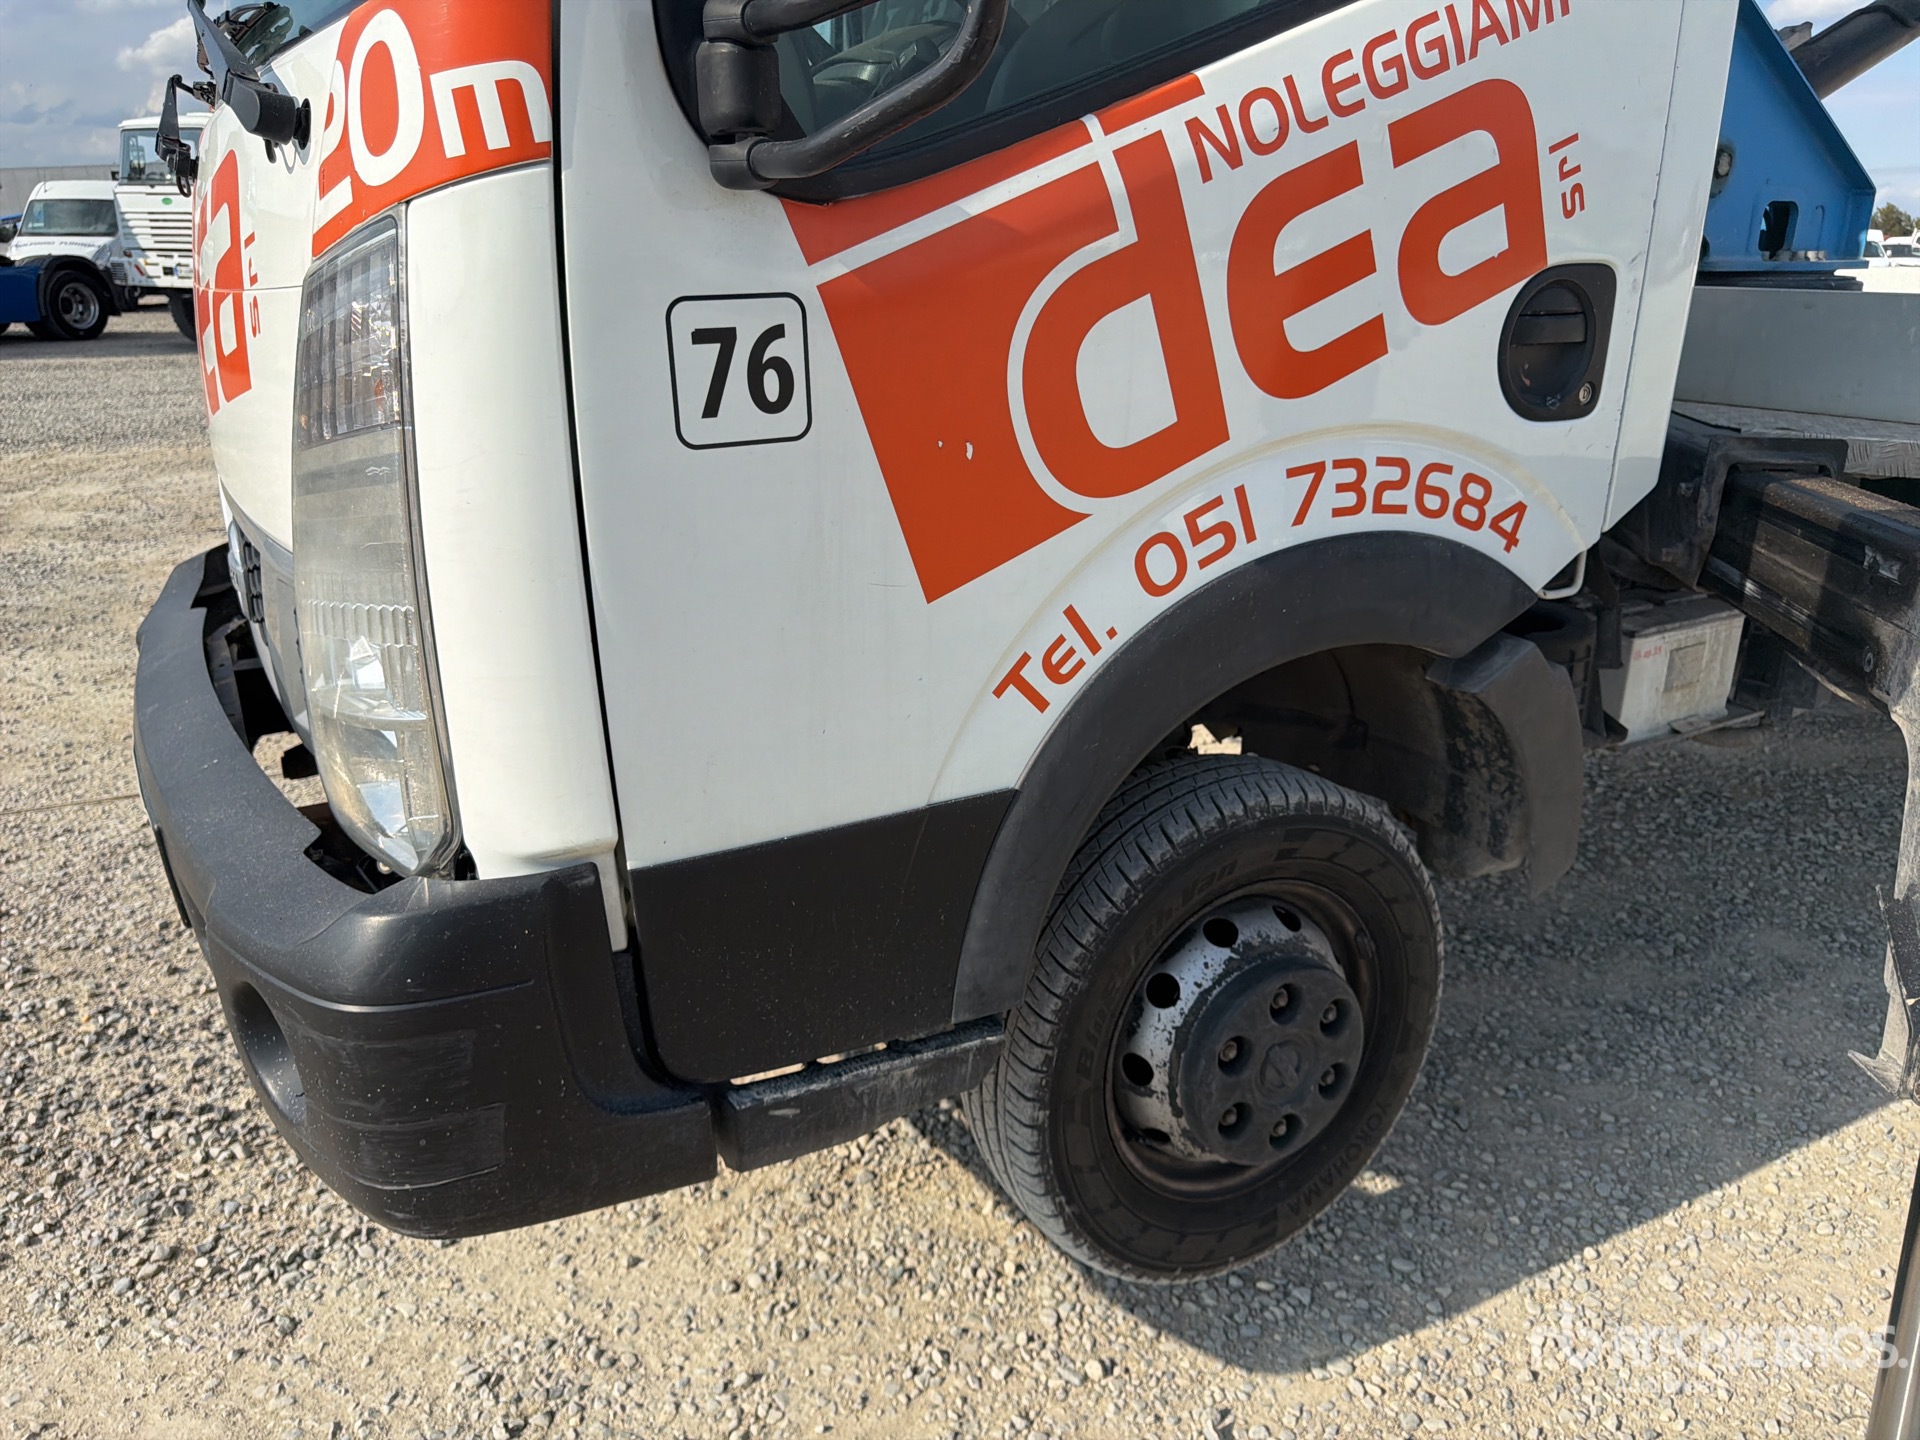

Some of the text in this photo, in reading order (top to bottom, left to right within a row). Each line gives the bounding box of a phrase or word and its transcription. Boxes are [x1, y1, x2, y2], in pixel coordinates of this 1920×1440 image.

[313, 8, 552, 234] 20m
[1184, 0, 1571, 184] NOLEGGIAM
[1548, 132, 1585, 219] srl
[691, 323, 795, 419] 76
[991, 456, 1528, 715] Tel. 051 732684
[1285, 1100, 1393, 1217] YOKOHAMA
